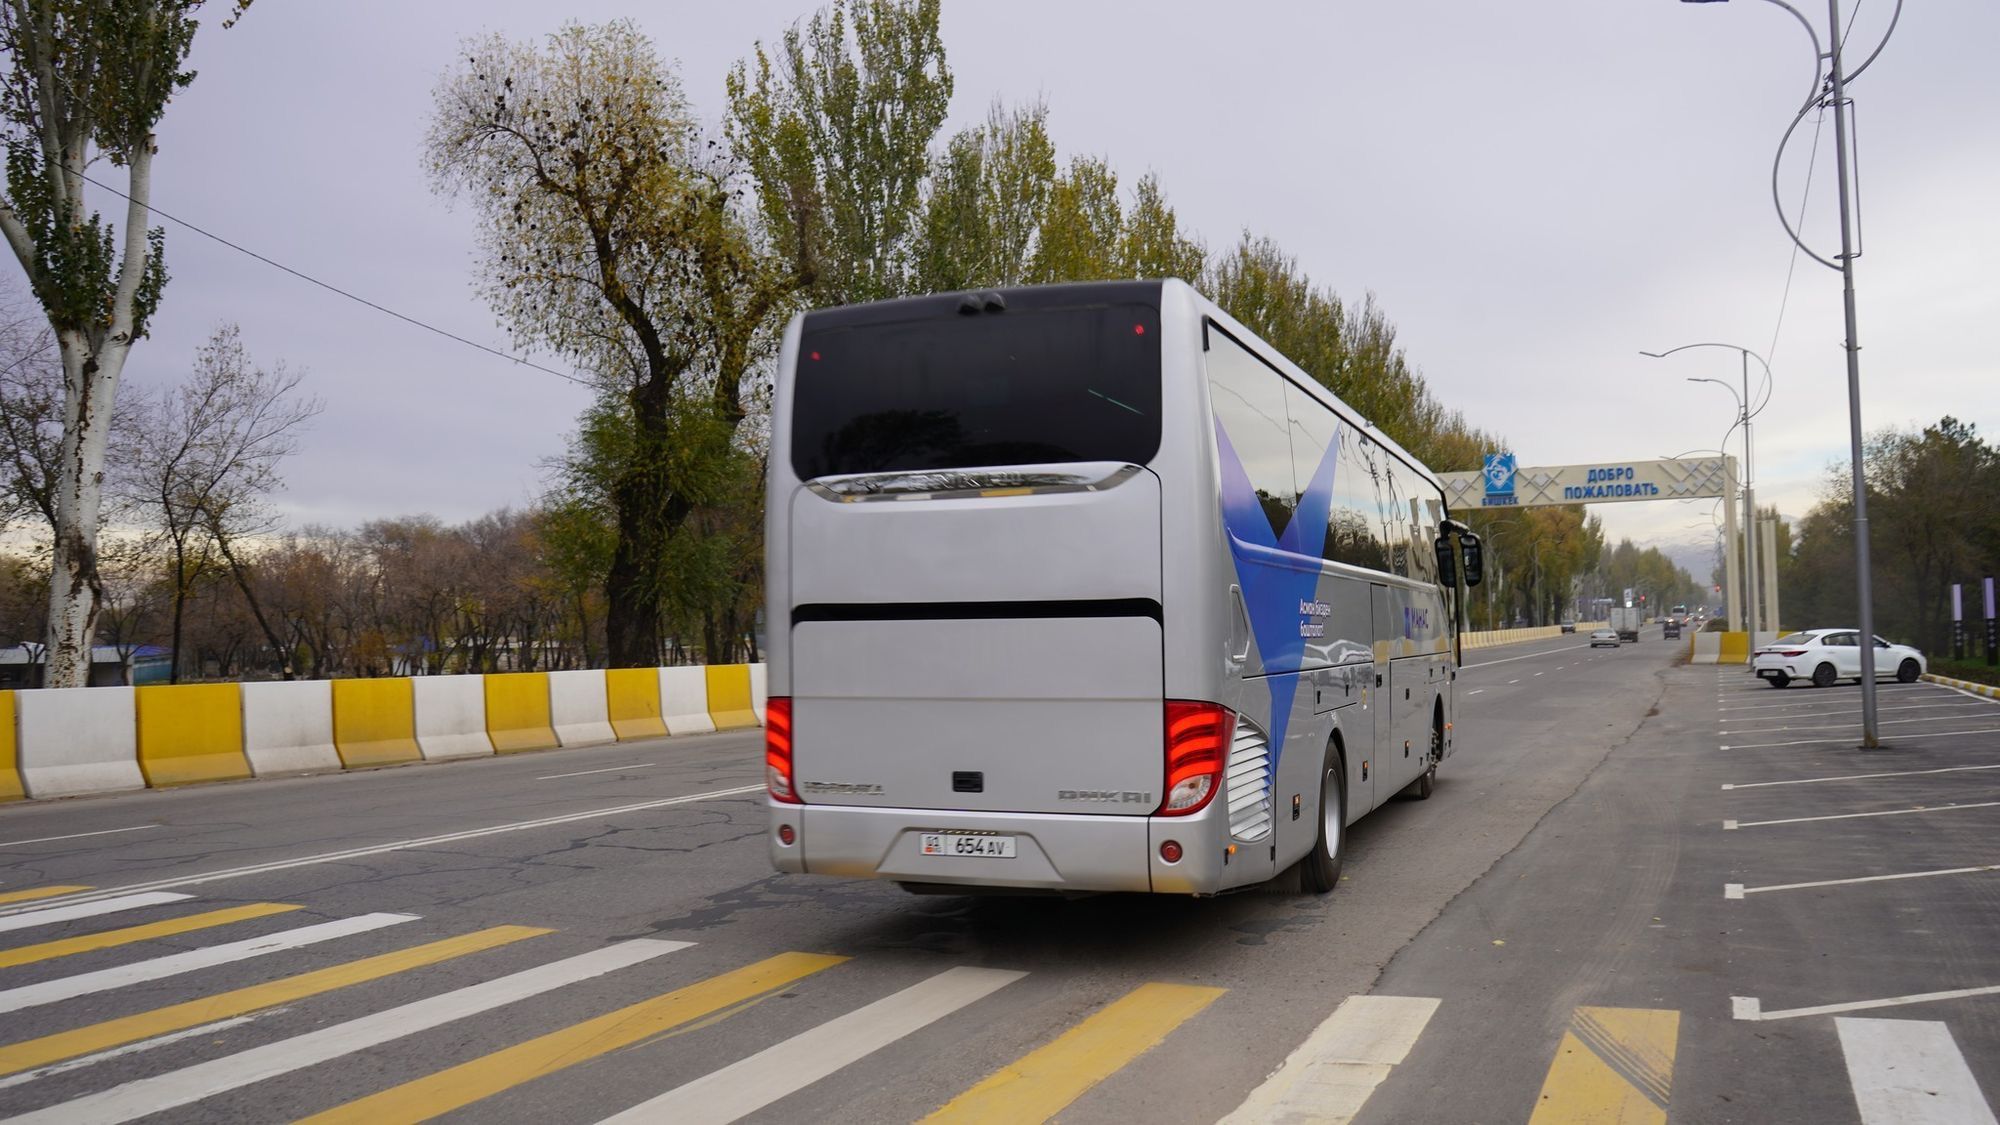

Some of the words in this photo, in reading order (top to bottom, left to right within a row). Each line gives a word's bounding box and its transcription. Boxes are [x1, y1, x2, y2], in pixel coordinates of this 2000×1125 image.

[1587, 467, 1634, 484] ДОБРО
[1564, 482, 1659, 500] ПОЖАЛОВАТЬ
[1482, 496, 1520, 506] БИШКЕК
[1411, 607, 1429, 630] МАНАС
